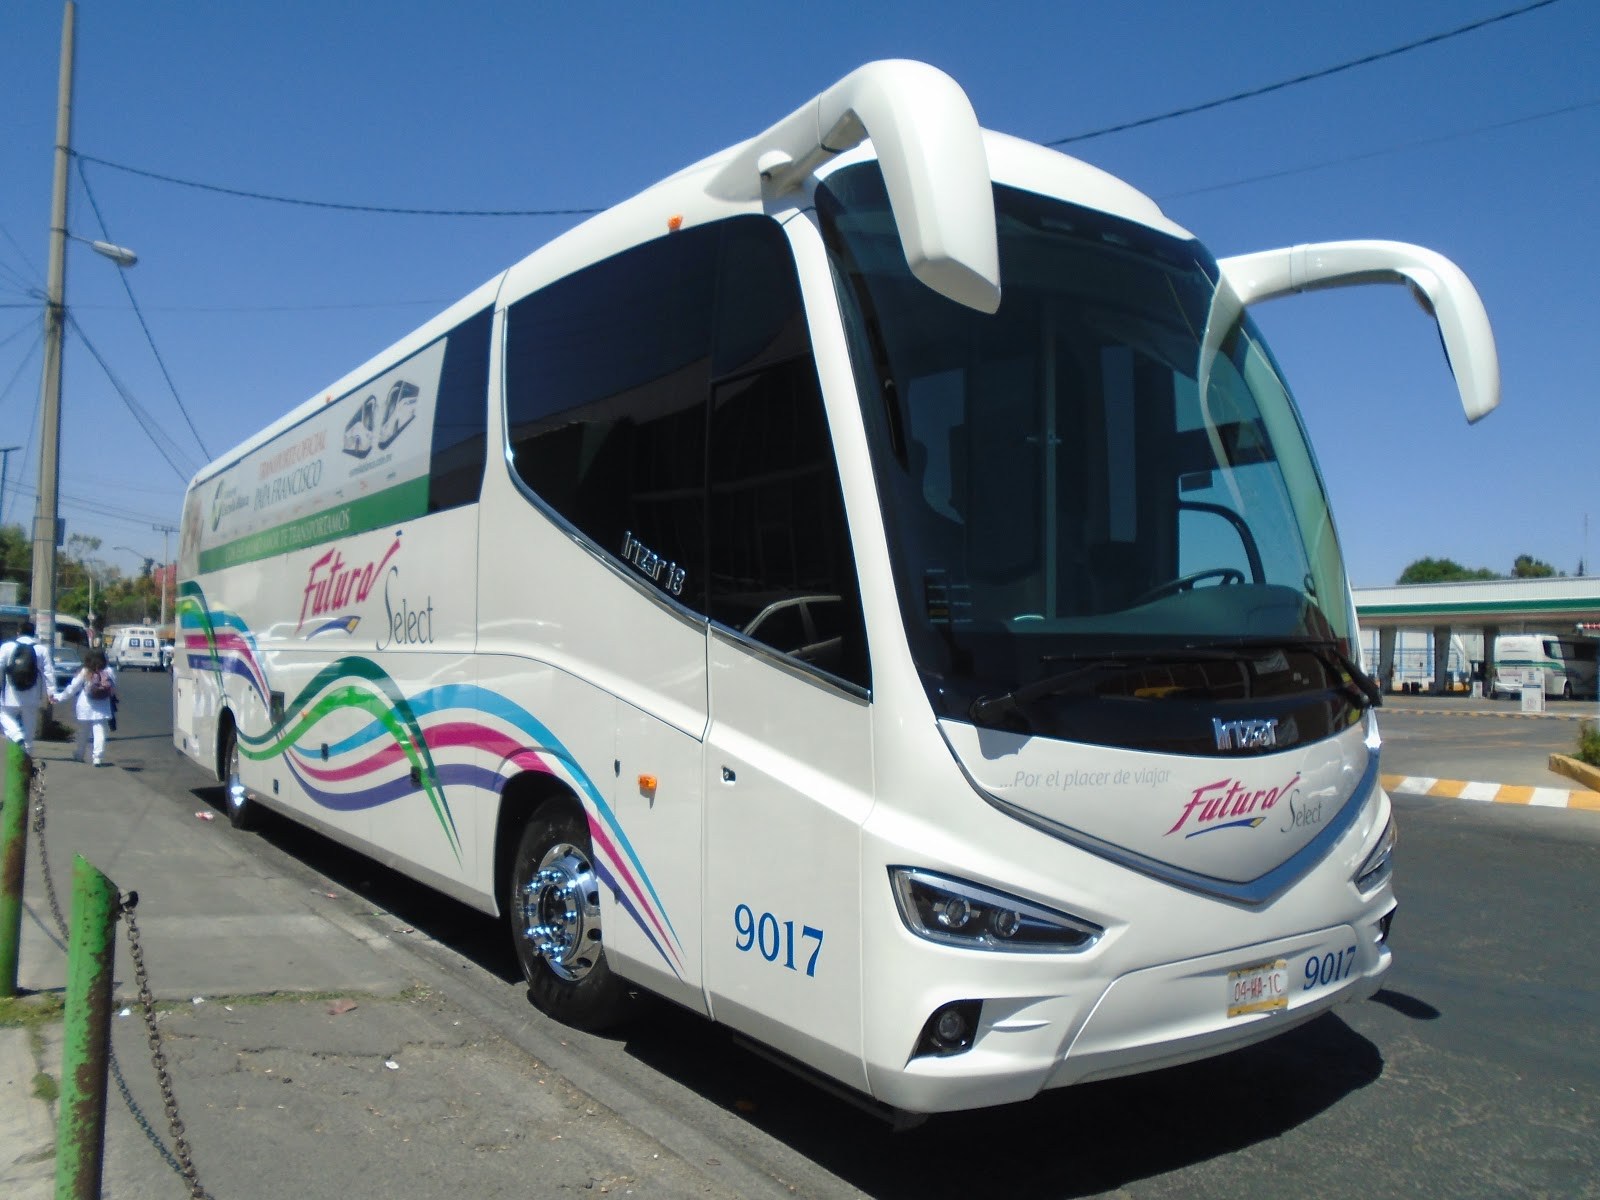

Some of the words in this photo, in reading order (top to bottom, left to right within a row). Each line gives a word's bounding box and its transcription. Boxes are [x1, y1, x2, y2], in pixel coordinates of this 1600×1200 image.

[271, 459, 322, 501] FRANCISCO
[294, 531, 402, 636] Futura
[376, 566, 434, 651] Select
[1045, 770, 1060, 786] el
[1064, 769, 1110, 791] placer
[1113, 769, 1131, 785] de
[1135, 768, 1172, 788] viajar
[1163, 771, 1301, 838] Futura
[1280, 789, 1323, 834] Select
[734, 903, 824, 978] 9017
[1303, 946, 1357, 991] 9017
